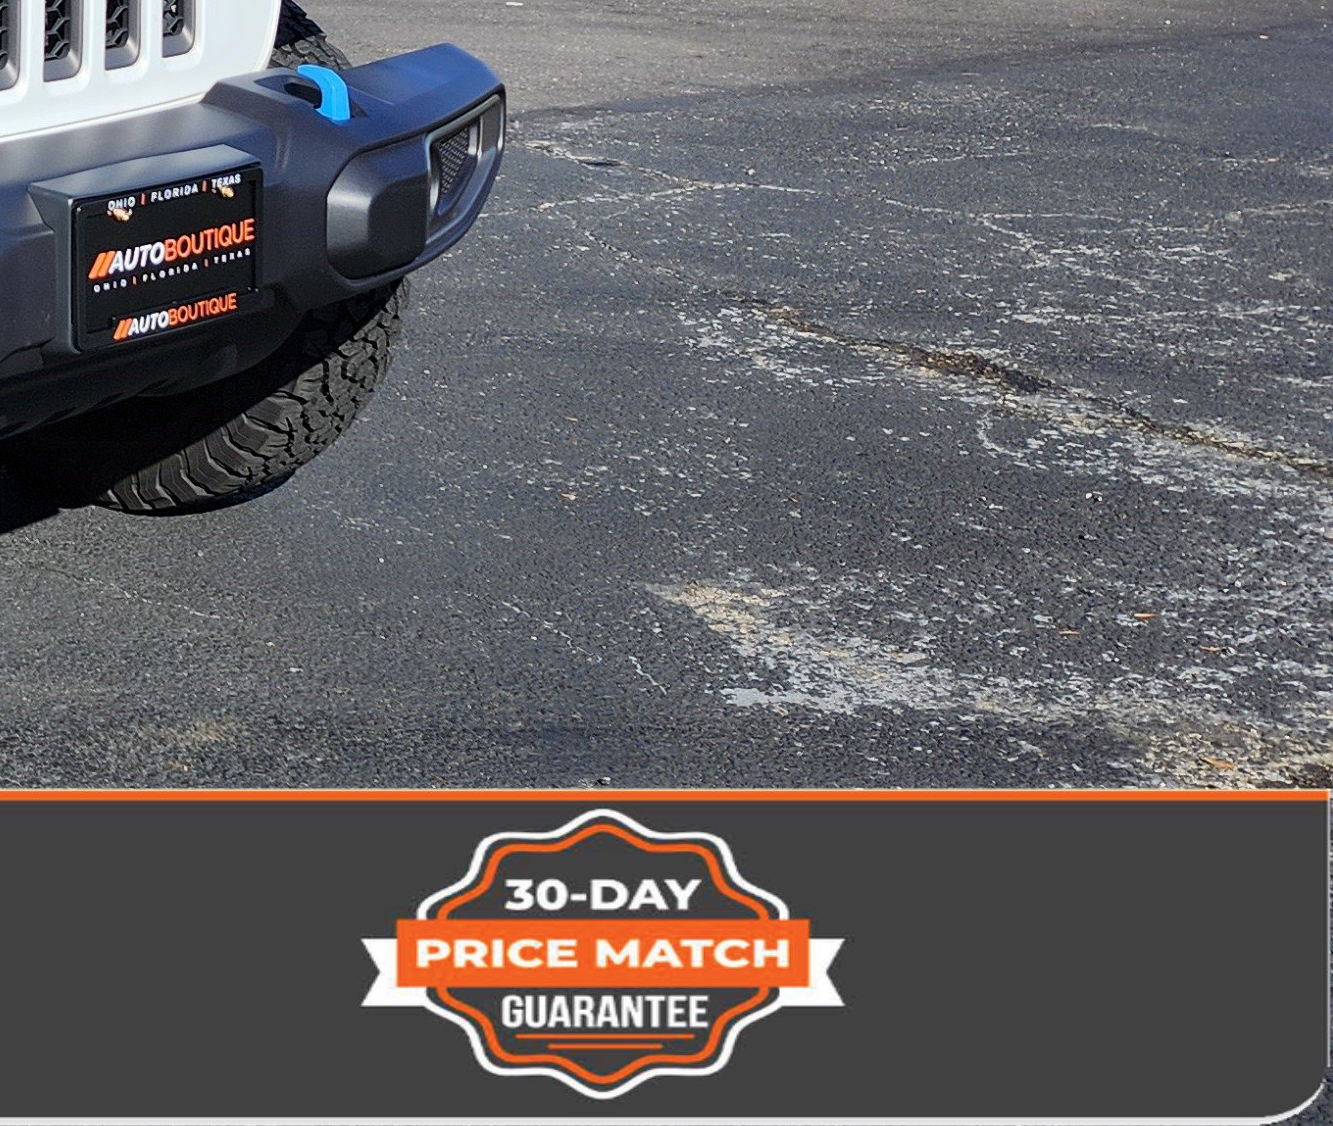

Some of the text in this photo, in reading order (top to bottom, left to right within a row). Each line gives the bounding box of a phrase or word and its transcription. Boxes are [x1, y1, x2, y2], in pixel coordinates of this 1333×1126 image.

[150, 183, 199, 203] FLORIDA
[211, 173, 242, 189] TEXAS
[107, 218, 256, 275] AUTOBOUTIQUE
[93, 277, 127, 293] OHIO
[142, 262, 198, 282] FLORIDA
[127, 292, 238, 336] AUTOBOUTIQUE
